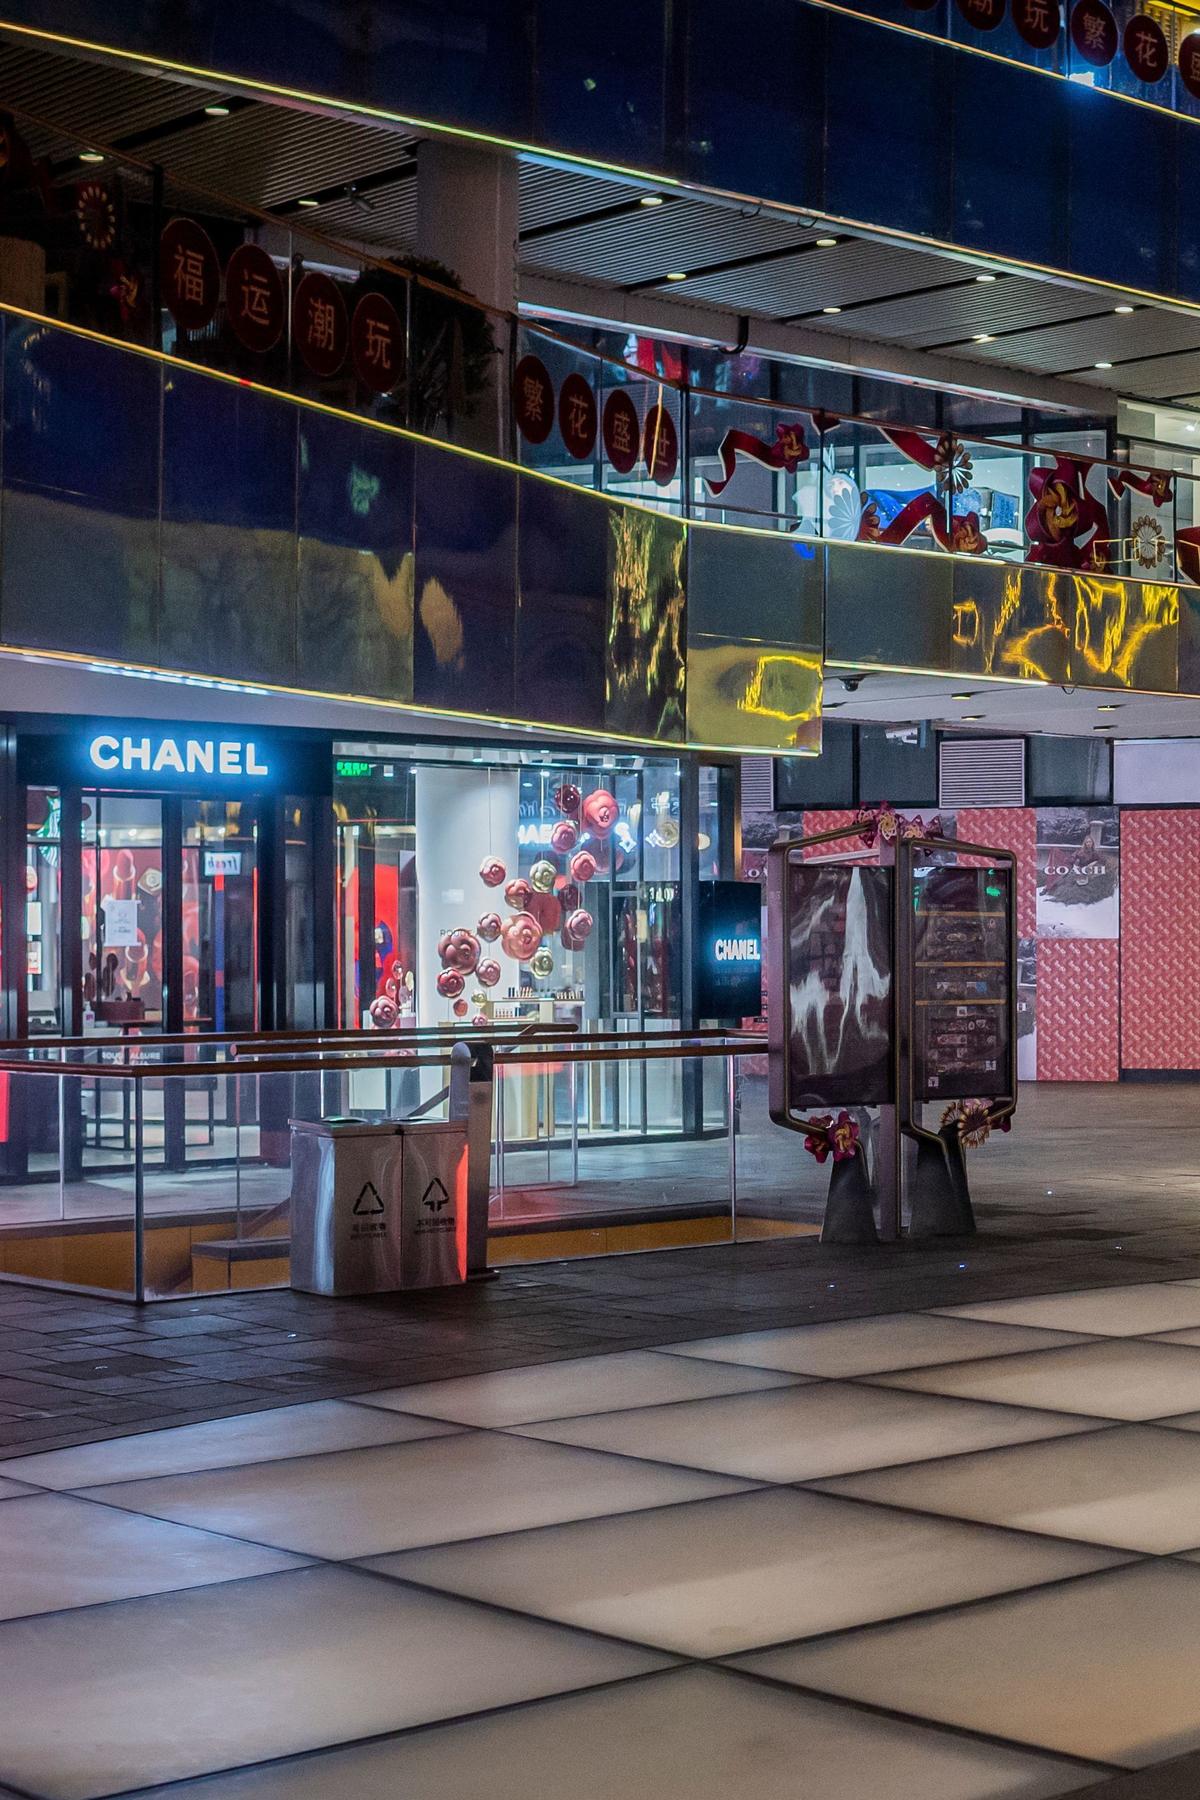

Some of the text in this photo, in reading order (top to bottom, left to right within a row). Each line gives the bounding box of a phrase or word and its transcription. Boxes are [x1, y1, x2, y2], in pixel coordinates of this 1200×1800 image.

[174, 246, 392, 370] 福运潮玩
[90, 735, 269, 776] CHANEL
[1044, 865, 1106, 875] COACH
[715, 939, 761, 961] CHANEL
